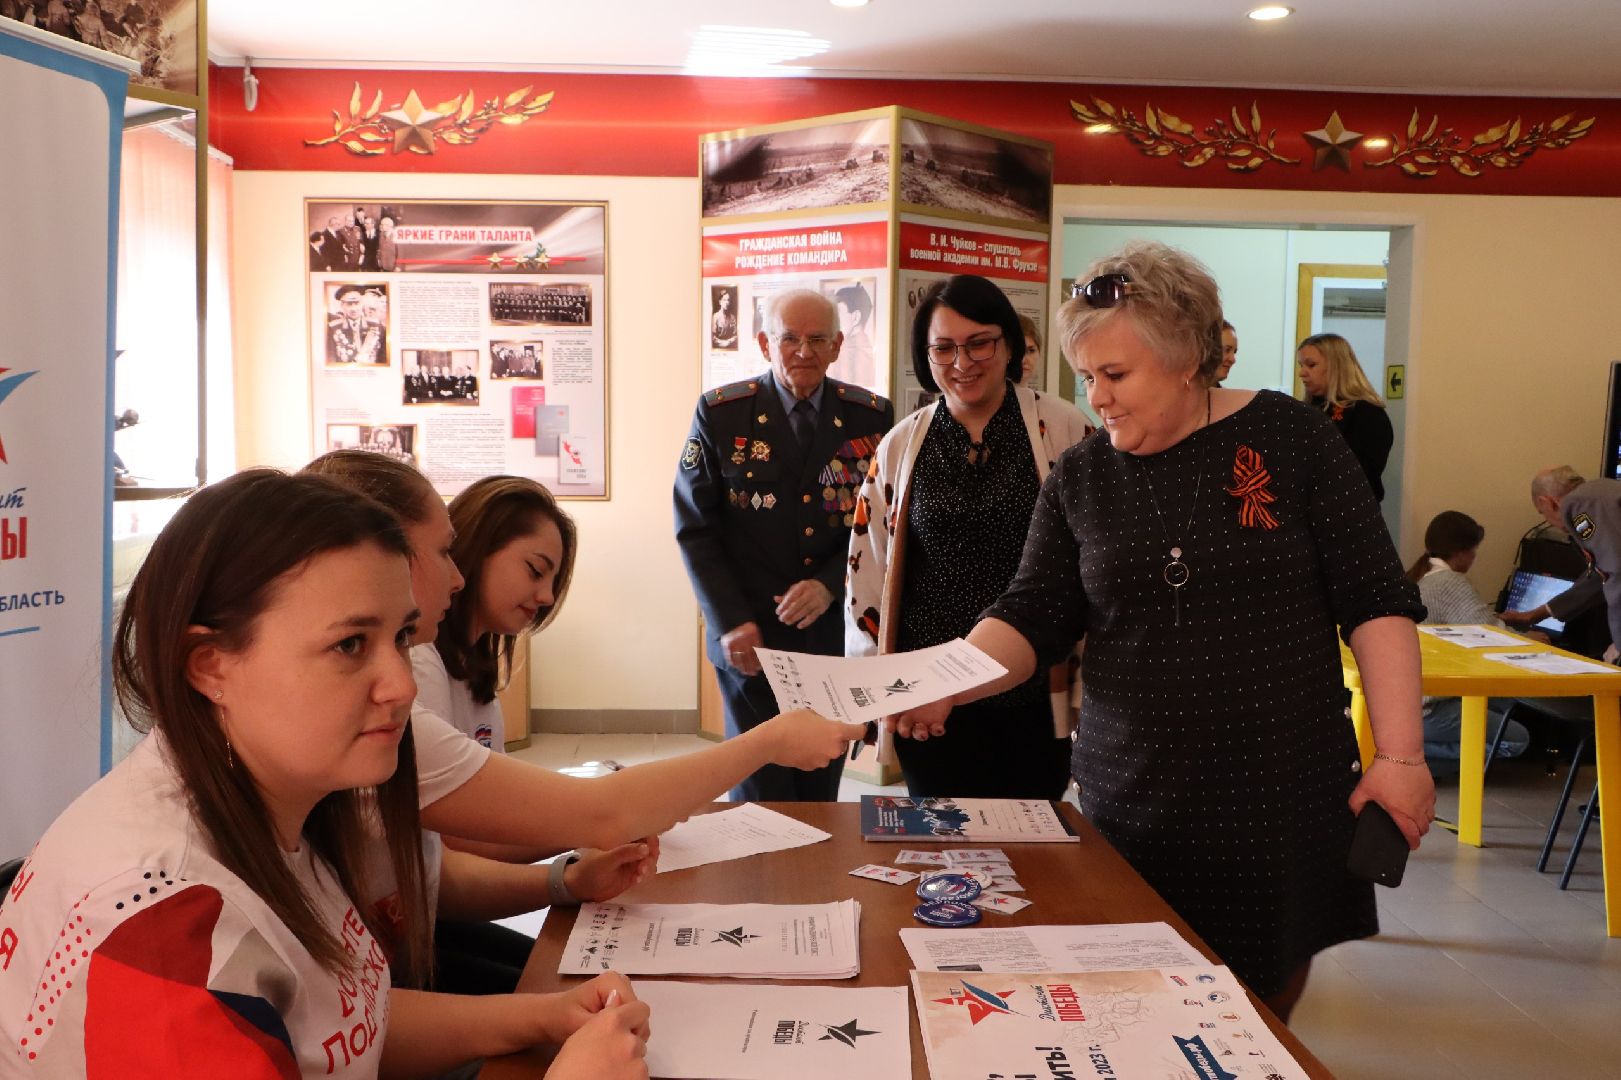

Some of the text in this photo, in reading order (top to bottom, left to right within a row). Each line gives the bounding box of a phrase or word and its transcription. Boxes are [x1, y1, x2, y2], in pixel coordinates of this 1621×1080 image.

[396, 229, 533, 242] ЯРКИЕ ГРАНИ ТАЛАНТА
[739, 230, 843, 252] ГРАЖДАНСКАЯ ВОЙНА
[930, 233, 939, 246] В.
[940, 234, 949, 247] И.
[950, 235, 977, 251] Чуйков
[983, 242, 1022, 256] слушатель
[735, 249, 848, 269] РОЖДЕНИЕ КОМАНДИРА
[909, 248, 941, 261] военной
[942, 251, 980, 266] академии
[1012, 258, 1038, 273] Фрунзе
[0, 590, 65, 612] БЛАСТЬ
[1030, 984, 1056, 1021] Диктант
[1046, 984, 1086, 1022] ПОБЕДЫ
[773, 1020, 796, 1045] ПОБЕДЫ
[1035, 1046, 1077, 1080] ить!
[1088, 1053, 1115, 1075] 2023
